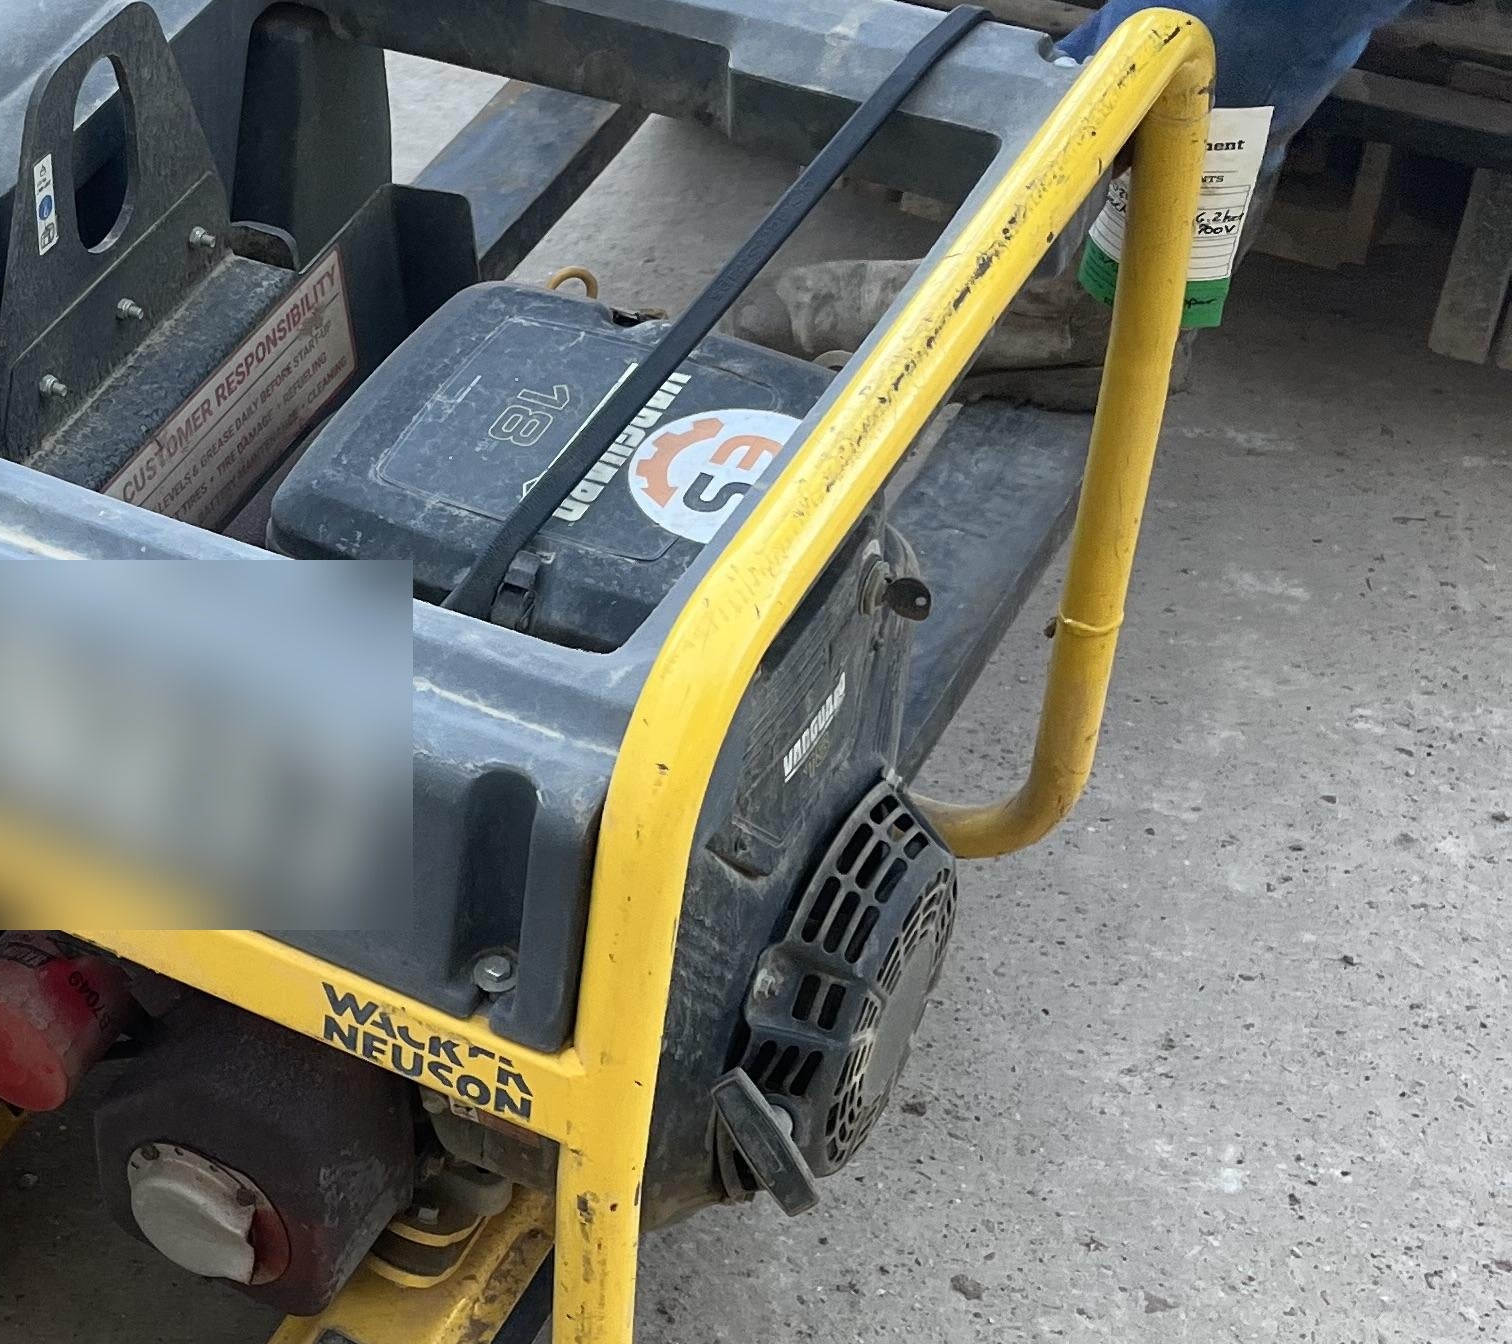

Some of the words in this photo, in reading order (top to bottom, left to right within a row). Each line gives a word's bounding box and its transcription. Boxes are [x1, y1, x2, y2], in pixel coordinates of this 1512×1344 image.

[122, 399, 214, 503] CUSTOMER
[215, 264, 336, 407] RESPONSIBILITY
[200, 424, 235, 468] GREASE
[235, 397, 259, 432] DAILY
[259, 362, 292, 404] BEFORE
[488, 385, 570, 447] 18
[181, 481, 208, 513] TIRES
[216, 449, 236, 476] TIRE
[323, 1014, 532, 1119] NEUSON
